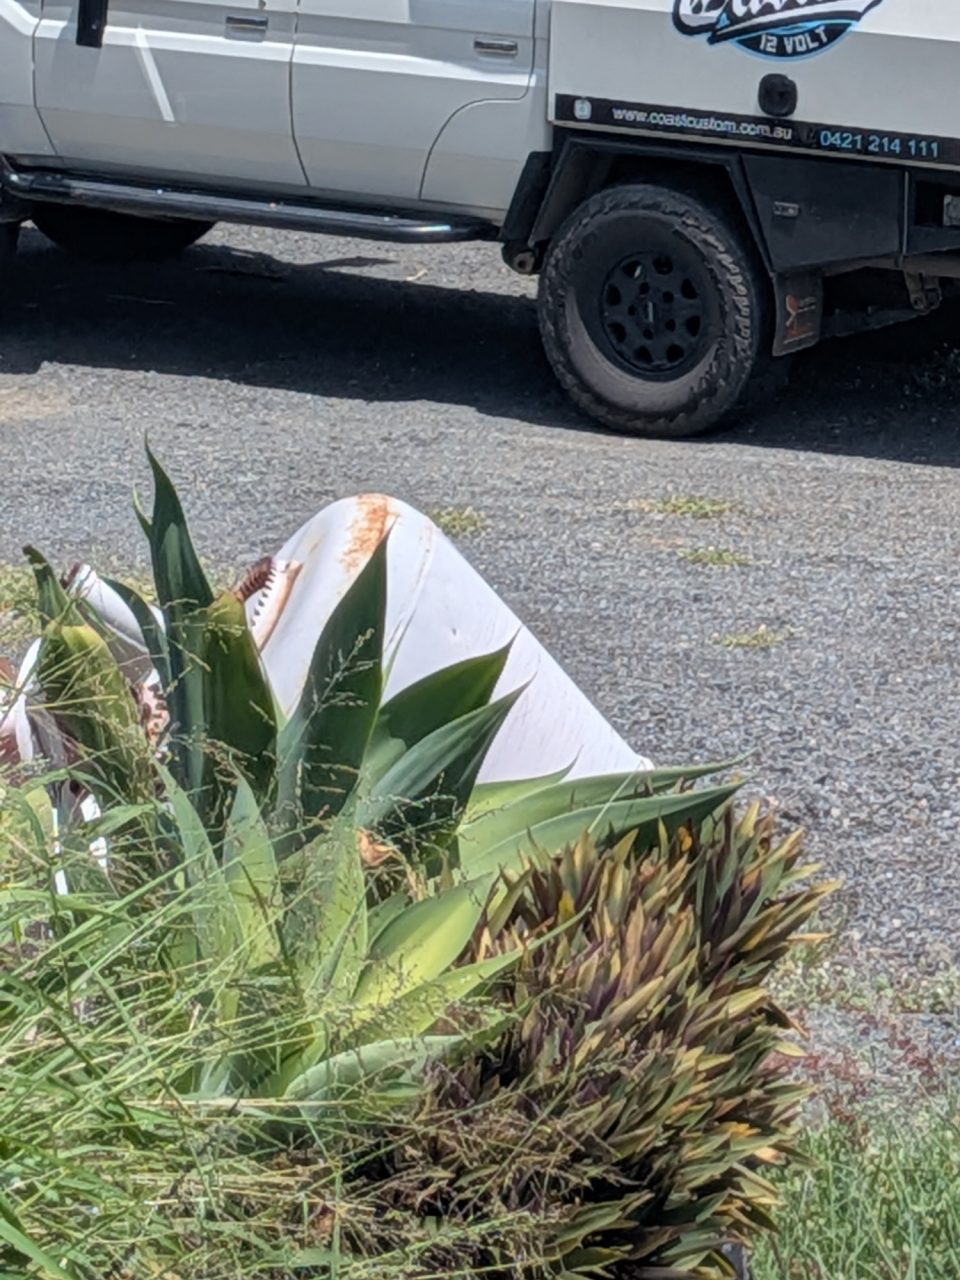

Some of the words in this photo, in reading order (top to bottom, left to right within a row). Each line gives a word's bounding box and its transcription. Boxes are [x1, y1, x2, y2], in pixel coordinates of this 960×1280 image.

[758, 33, 777, 53] 12
[784, 25, 829, 54] VOLT
[820, 130, 862, 149] 0421
[868, 135, 900, 153] 214
[908, 139, 939, 158] 111
